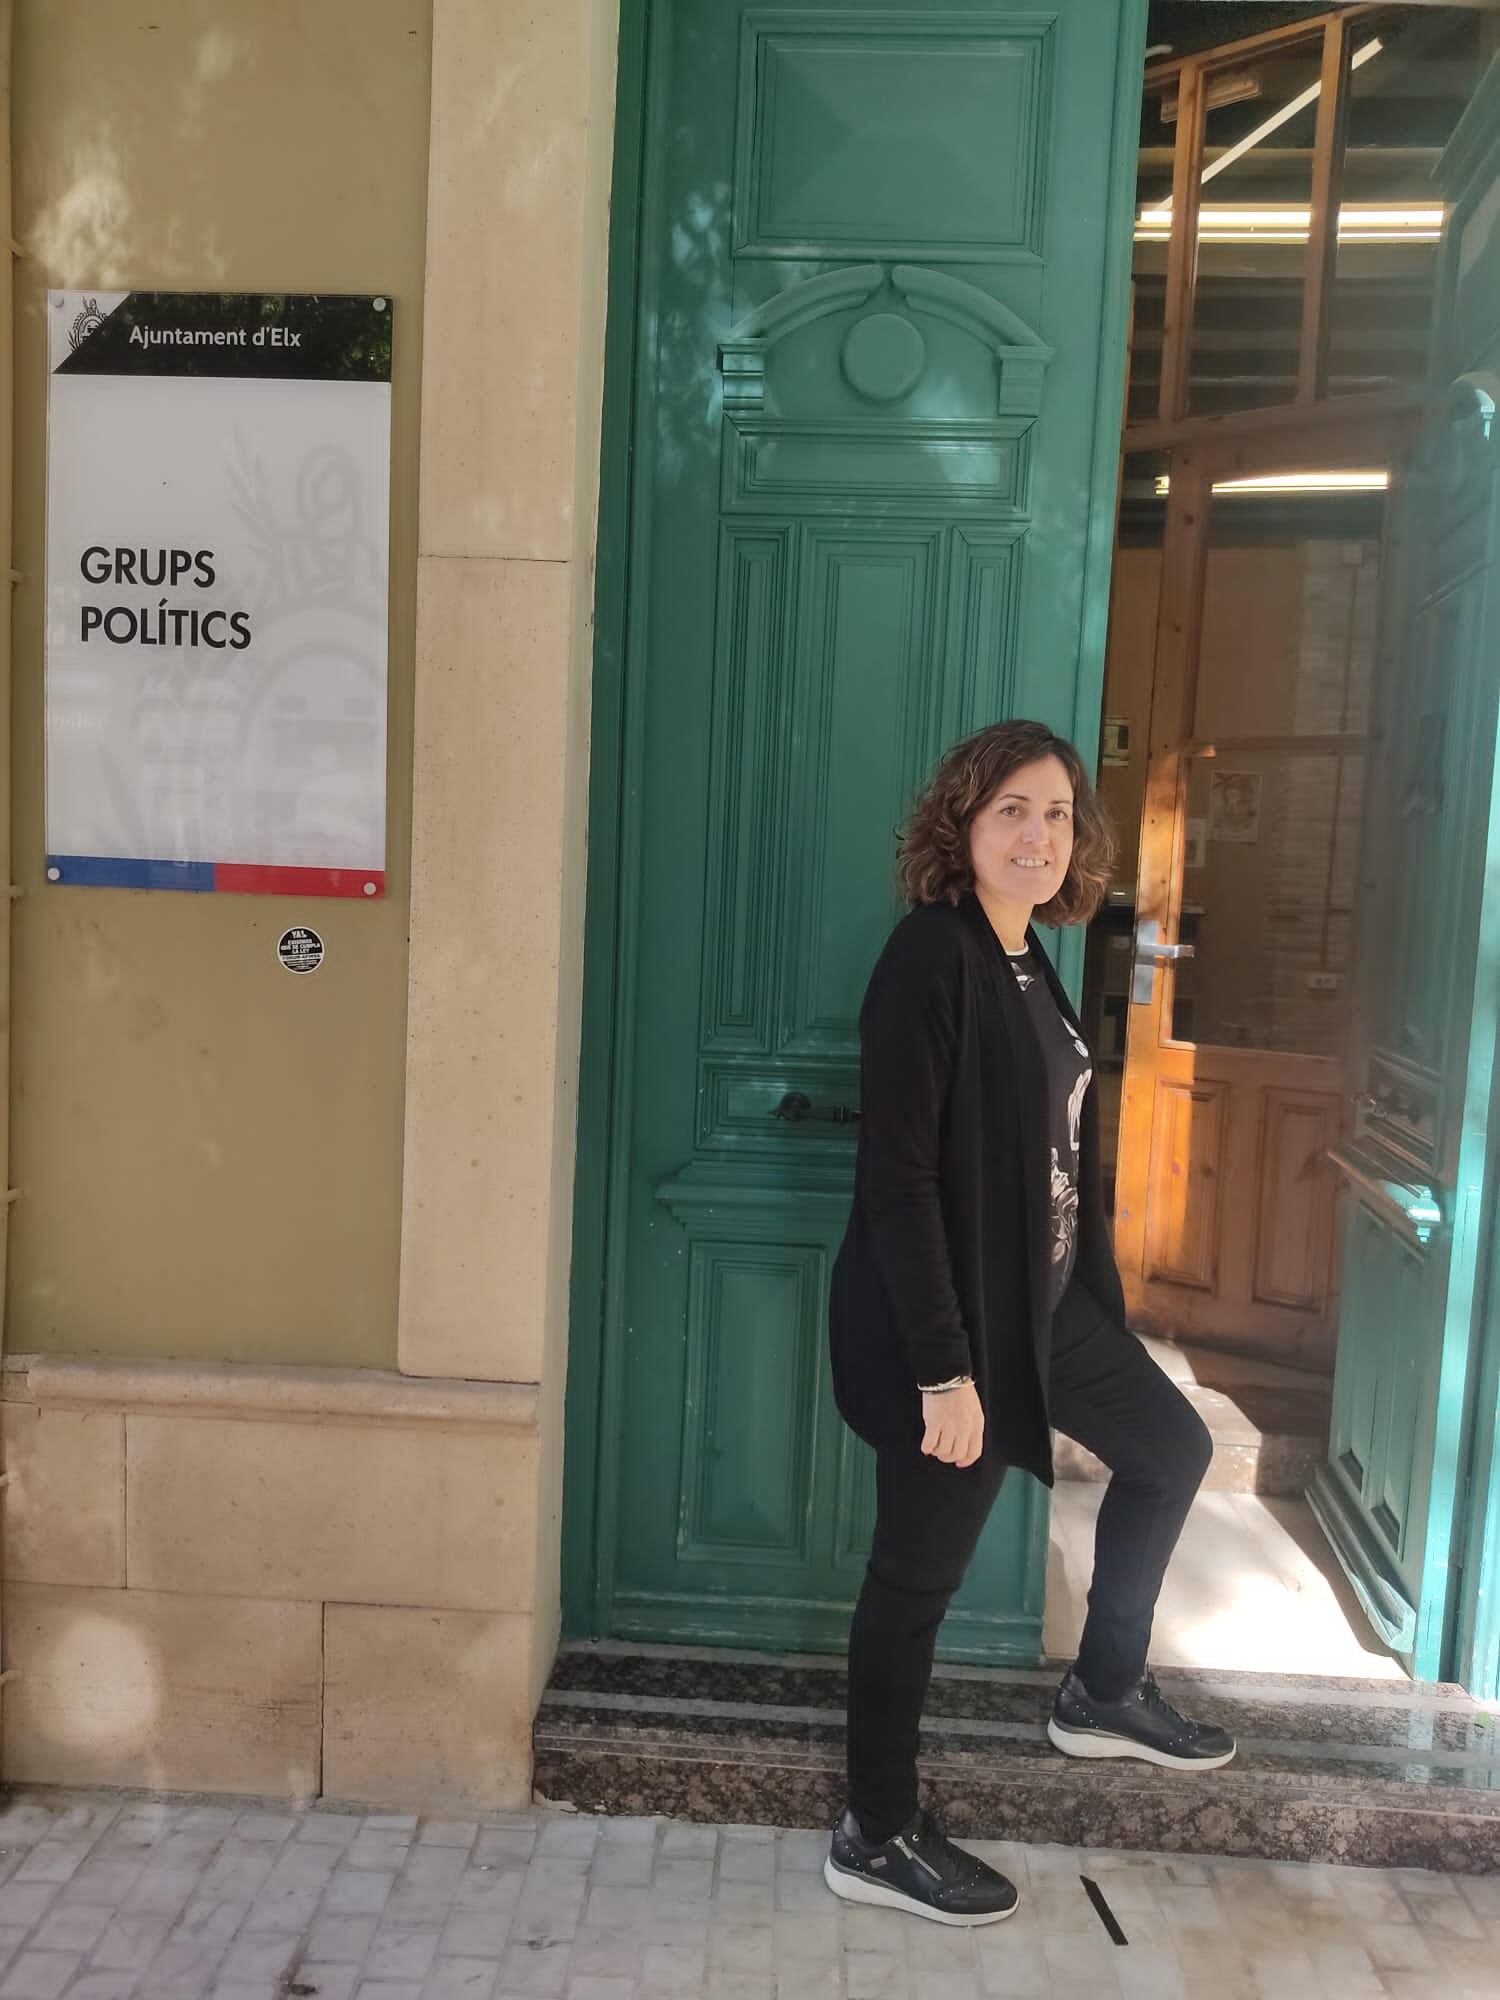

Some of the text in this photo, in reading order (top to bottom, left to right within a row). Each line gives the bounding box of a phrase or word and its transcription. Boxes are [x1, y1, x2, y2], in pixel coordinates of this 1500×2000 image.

[129, 325, 301, 349] Ajuntament d'Elx
[80, 546, 216, 588] GRUPS
[80, 598, 252, 650] POLÍTICS
